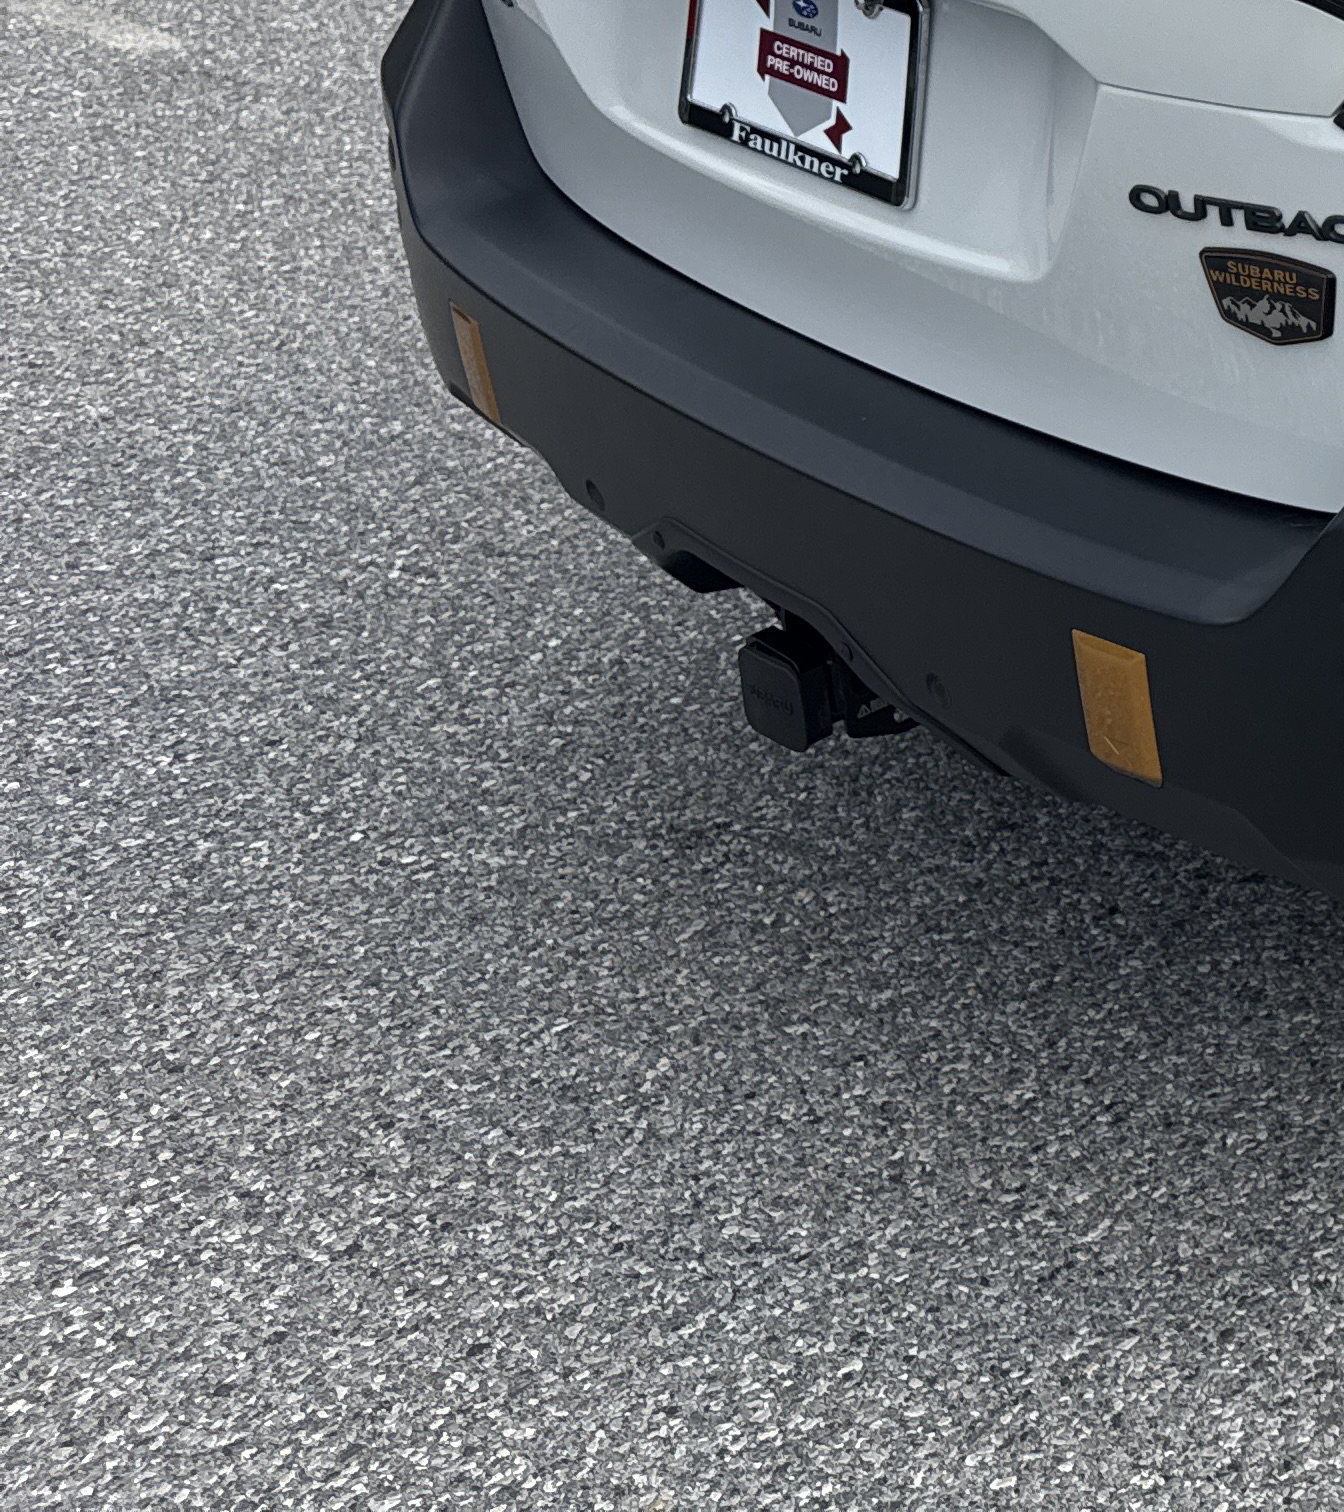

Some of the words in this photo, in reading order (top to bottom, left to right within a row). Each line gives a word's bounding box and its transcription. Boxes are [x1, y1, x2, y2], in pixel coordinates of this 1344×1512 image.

[788, 17, 822, 38] SUBARU
[773, 40, 834, 73] CERTIFIED
[766, 55, 839, 92] PRE-OWNED
[731, 119, 849, 183] Faulkner
[1209, 269, 1320, 301] WILDERNESS
[1226, 260, 1297, 284] SUBARU
